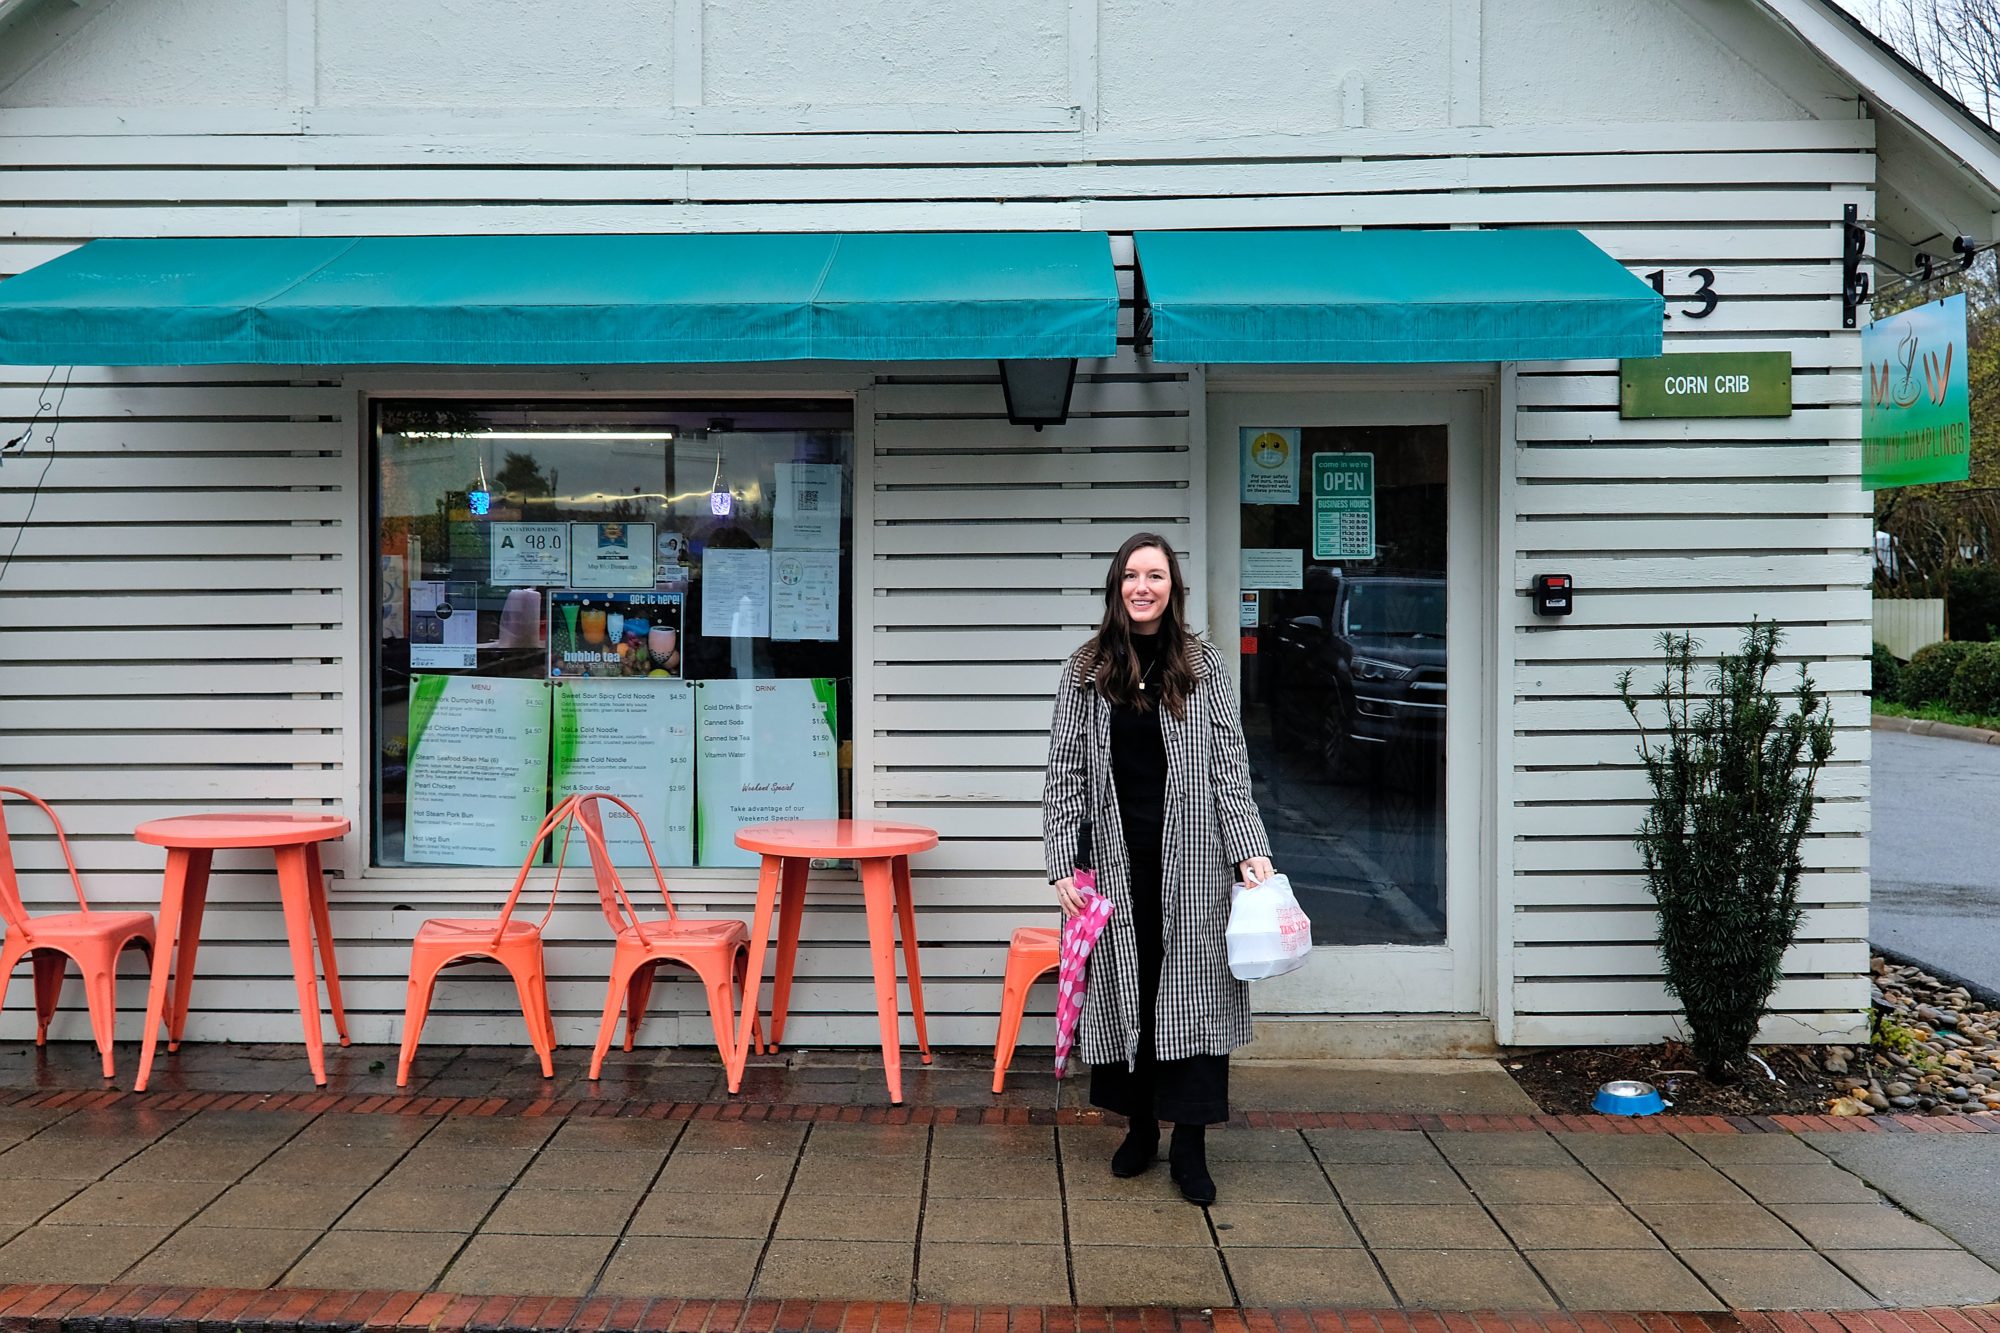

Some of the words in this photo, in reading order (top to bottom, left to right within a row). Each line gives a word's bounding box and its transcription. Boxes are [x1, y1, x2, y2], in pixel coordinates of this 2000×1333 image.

[1645, 268, 1718, 319] 13
[1665, 376, 1708, 395] CORN
[1715, 375, 1750, 394] CRIB
[1903, 422, 1965, 461] DUMPLINGS
[1323, 471, 1365, 491] OPEN
[1318, 500, 1348, 508] BUSINESS
[1349, 500, 1370, 508] HOURS
[501, 535, 514, 548] A
[525, 534, 561, 549] 98.0
[629, 594, 645, 605] get
[647, 594, 656, 604] it
[657, 594, 680, 605] here!
[563, 650, 601, 662] bubble
[602, 652, 620, 662] tea
[451, 696, 484, 705] Dumplings
[460, 726, 494, 734] Dumplings
[495, 727, 504, 735] (6)
[432, 782, 456, 790] Chicken
[742, 783, 770, 792] Weekend
[770, 782, 795, 794] Special
[747, 805, 782, 813] advantage
